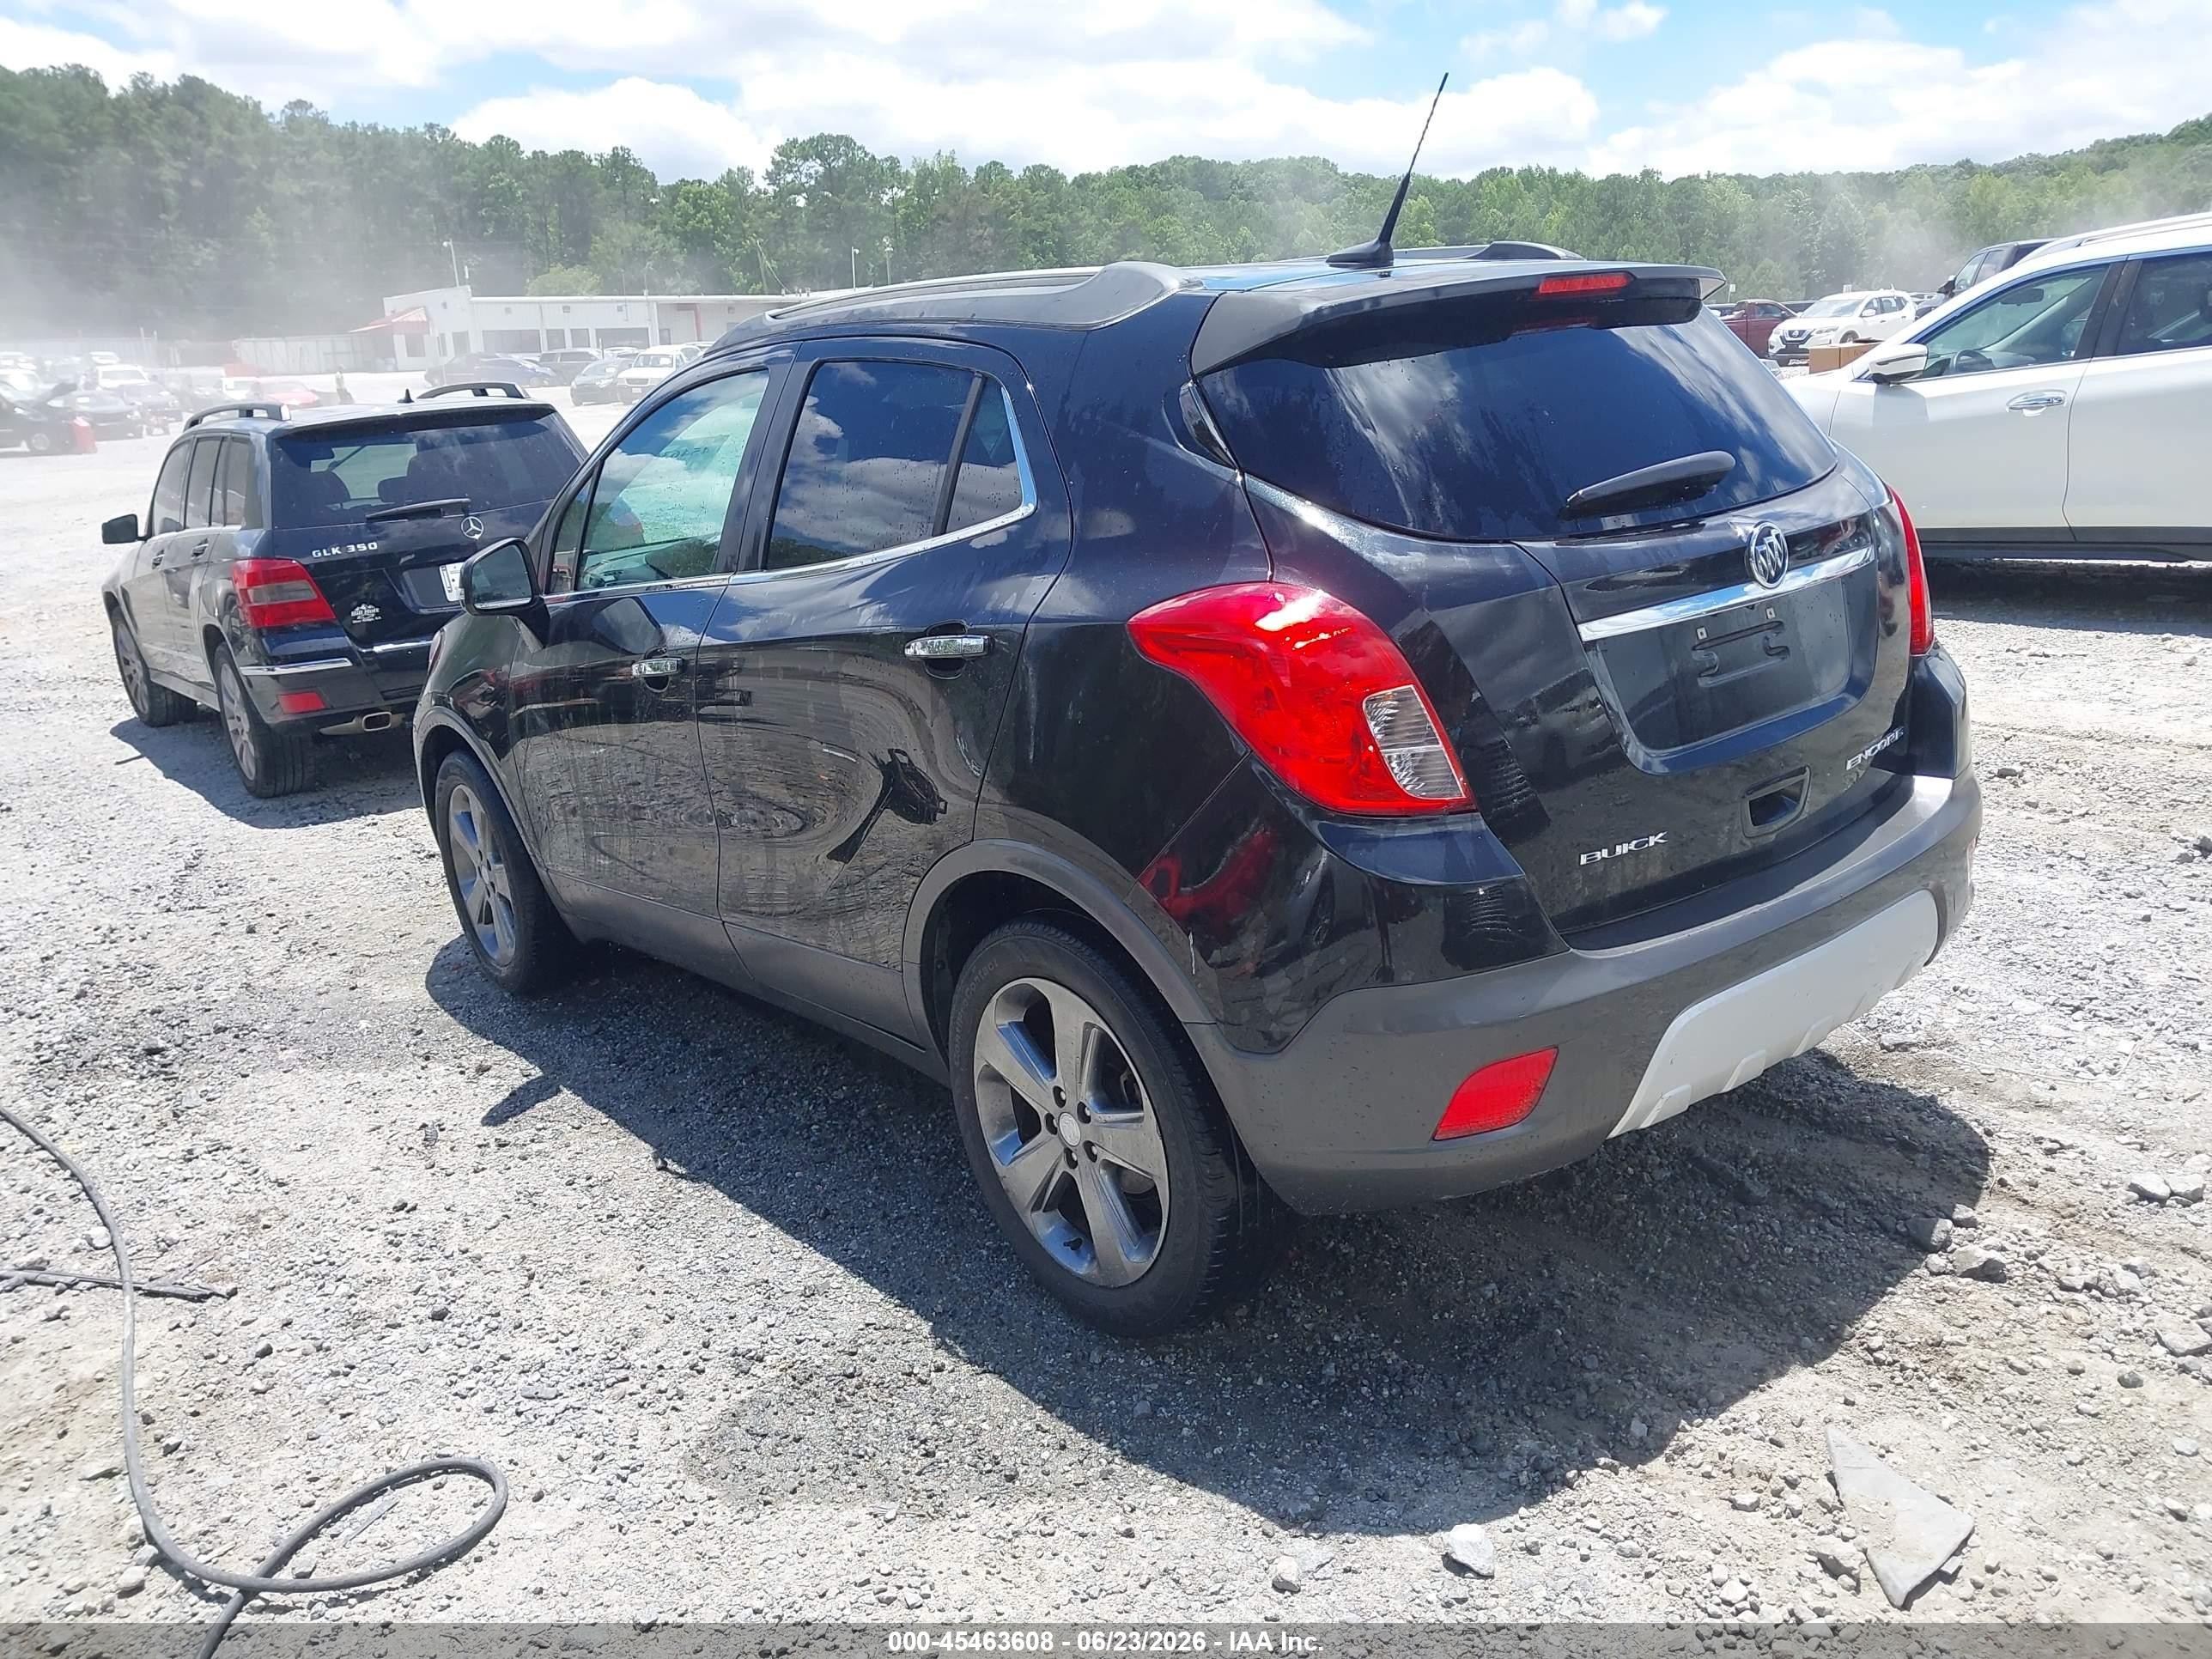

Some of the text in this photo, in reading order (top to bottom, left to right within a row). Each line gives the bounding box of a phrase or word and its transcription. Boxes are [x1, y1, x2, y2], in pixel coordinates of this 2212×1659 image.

[312, 542, 378, 558] GLK 350
[1846, 726, 1904, 771] ENCORE
[1579, 830, 1670, 866] BUICK
